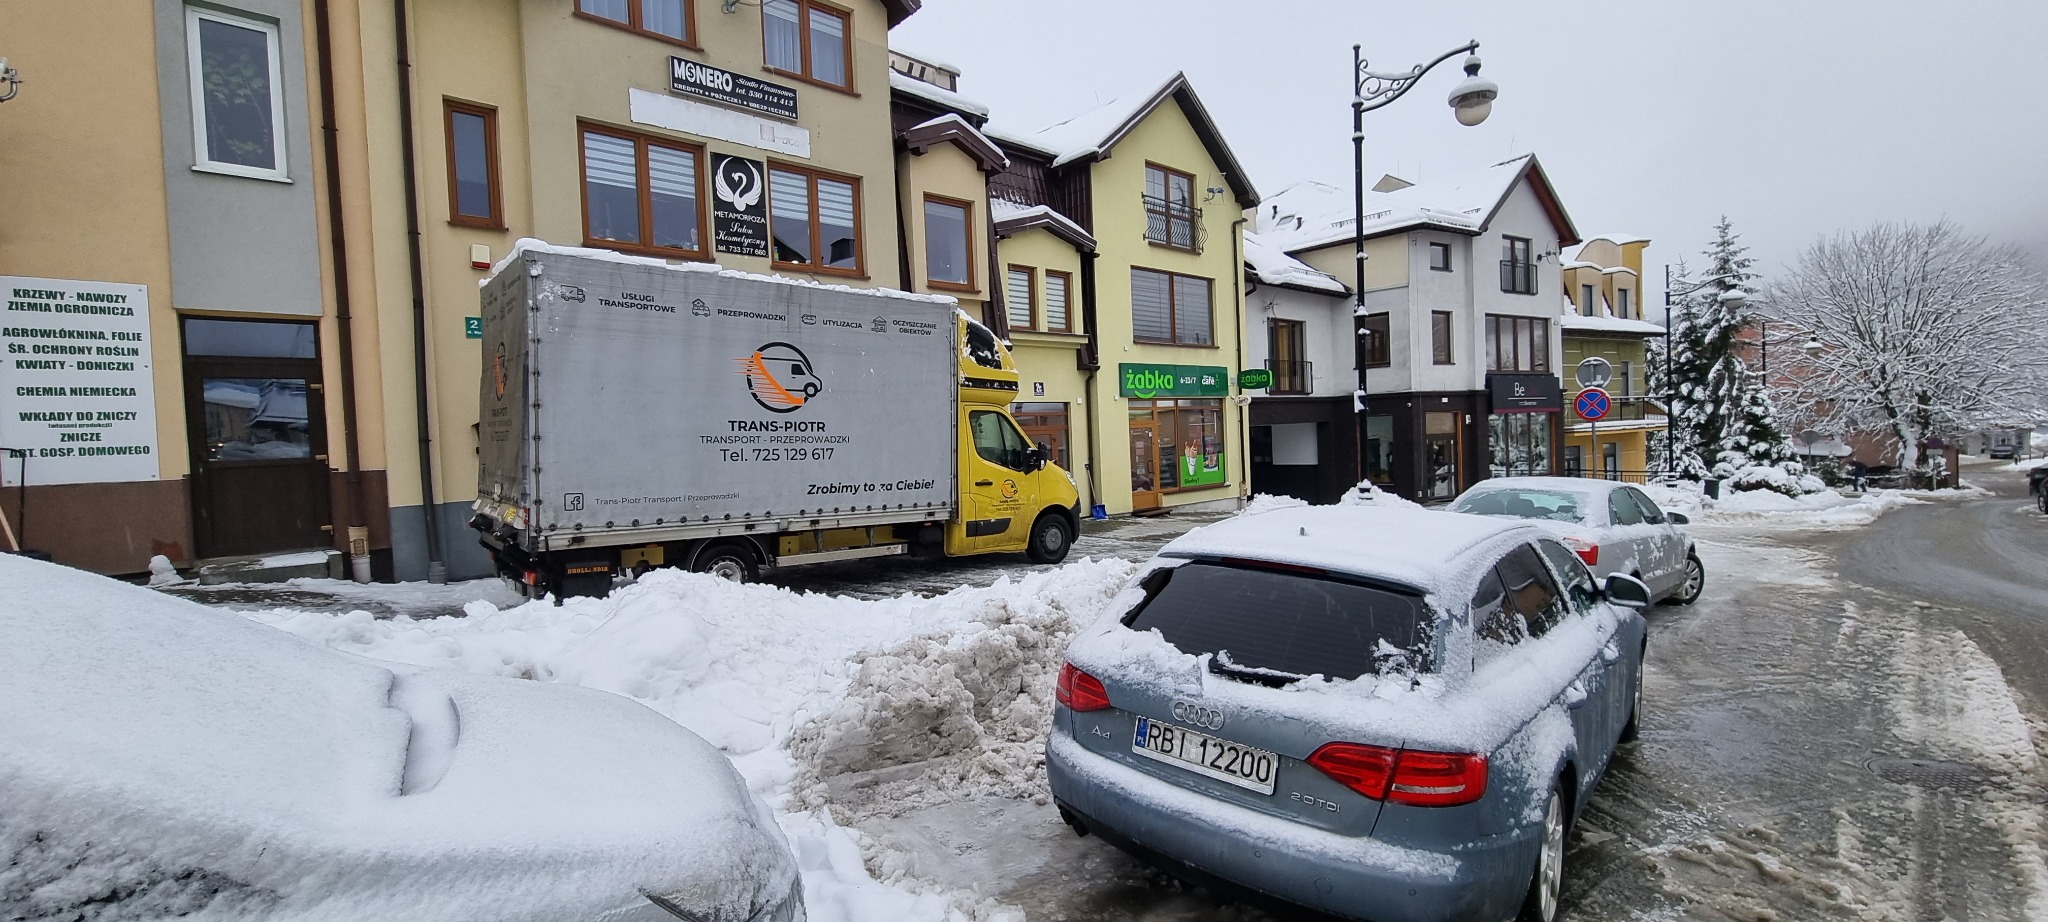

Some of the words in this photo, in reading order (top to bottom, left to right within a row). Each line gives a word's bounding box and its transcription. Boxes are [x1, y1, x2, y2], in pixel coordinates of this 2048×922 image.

[674, 82, 703, 95] KREDYTY
[748, 90, 763, 99] 530
[764, 94, 778, 104] 114
[779, 99, 794, 107] 415
[714, 210, 766, 224] METAMORFOZA
[729, 245, 741, 253] 733
[742, 247, 754, 255] 377
[13, 288, 66, 301] KRZEWY
[76, 292, 128, 304] NAWOZY
[621, 291, 655, 303] USŁUGI
[7, 301, 52, 313] ZIEMIA
[54, 303, 135, 317] OGRODNICZA
[598, 298, 677, 314] TRANSPORTOWE
[717, 308, 787, 322] PRZEPROWADZKI
[469, 320, 479, 329] 2
[822, 319, 863, 329] UTYLIZACJA
[892, 319, 938, 330] OCZYSZCZANIE
[111, 332, 143, 342] FOLIE
[8, 342, 30, 354] ŚR.
[32, 344, 93, 356] OCHRONY
[96, 343, 140, 357] ROŚLIN
[15, 360, 66, 370] KWIATY
[76, 361, 135, 371] DONICZKI
[1125, 368, 1174, 389] żabka
[1240, 374, 1268, 383] żabka
[16, 386, 67, 397] CHEMIA
[69, 387, 137, 397] NIEMIECKA
[1514, 382, 1525, 396] Be
[19, 411, 73, 422] WKŁADY
[76, 411, 93, 421] DO
[96, 411, 138, 421] ZNICZY
[728, 420, 826, 432] TRANS-PIOTR
[60, 432, 102, 443] ZNICZE
[700, 435, 761, 444] TRANSPORT
[769, 435, 850, 444] PRZEPROWADZKI
[40, 447, 76, 458] GOSP.
[78, 445, 151, 457] DOMOWEGO
[720, 448, 748, 462] Tel.
[752, 448, 780, 462] 725
[784, 448, 807, 461] 129
[811, 447, 834, 461] 617
[807, 482, 860, 495] Zrobimy
[863, 482, 876, 492] to
[878, 483, 893, 492] za
[896, 478, 935, 491] Ciebie!
[595, 497, 641, 505] Trans-Piotr
[643, 494, 682, 504] Transport
[687, 491, 740, 502] Przeprowadzki
[1092, 725, 1111, 740] A4
[1137, 735, 1145, 745] PL
[1147, 723, 1186, 758] RBI
[1200, 738, 1272, 783] 12200
